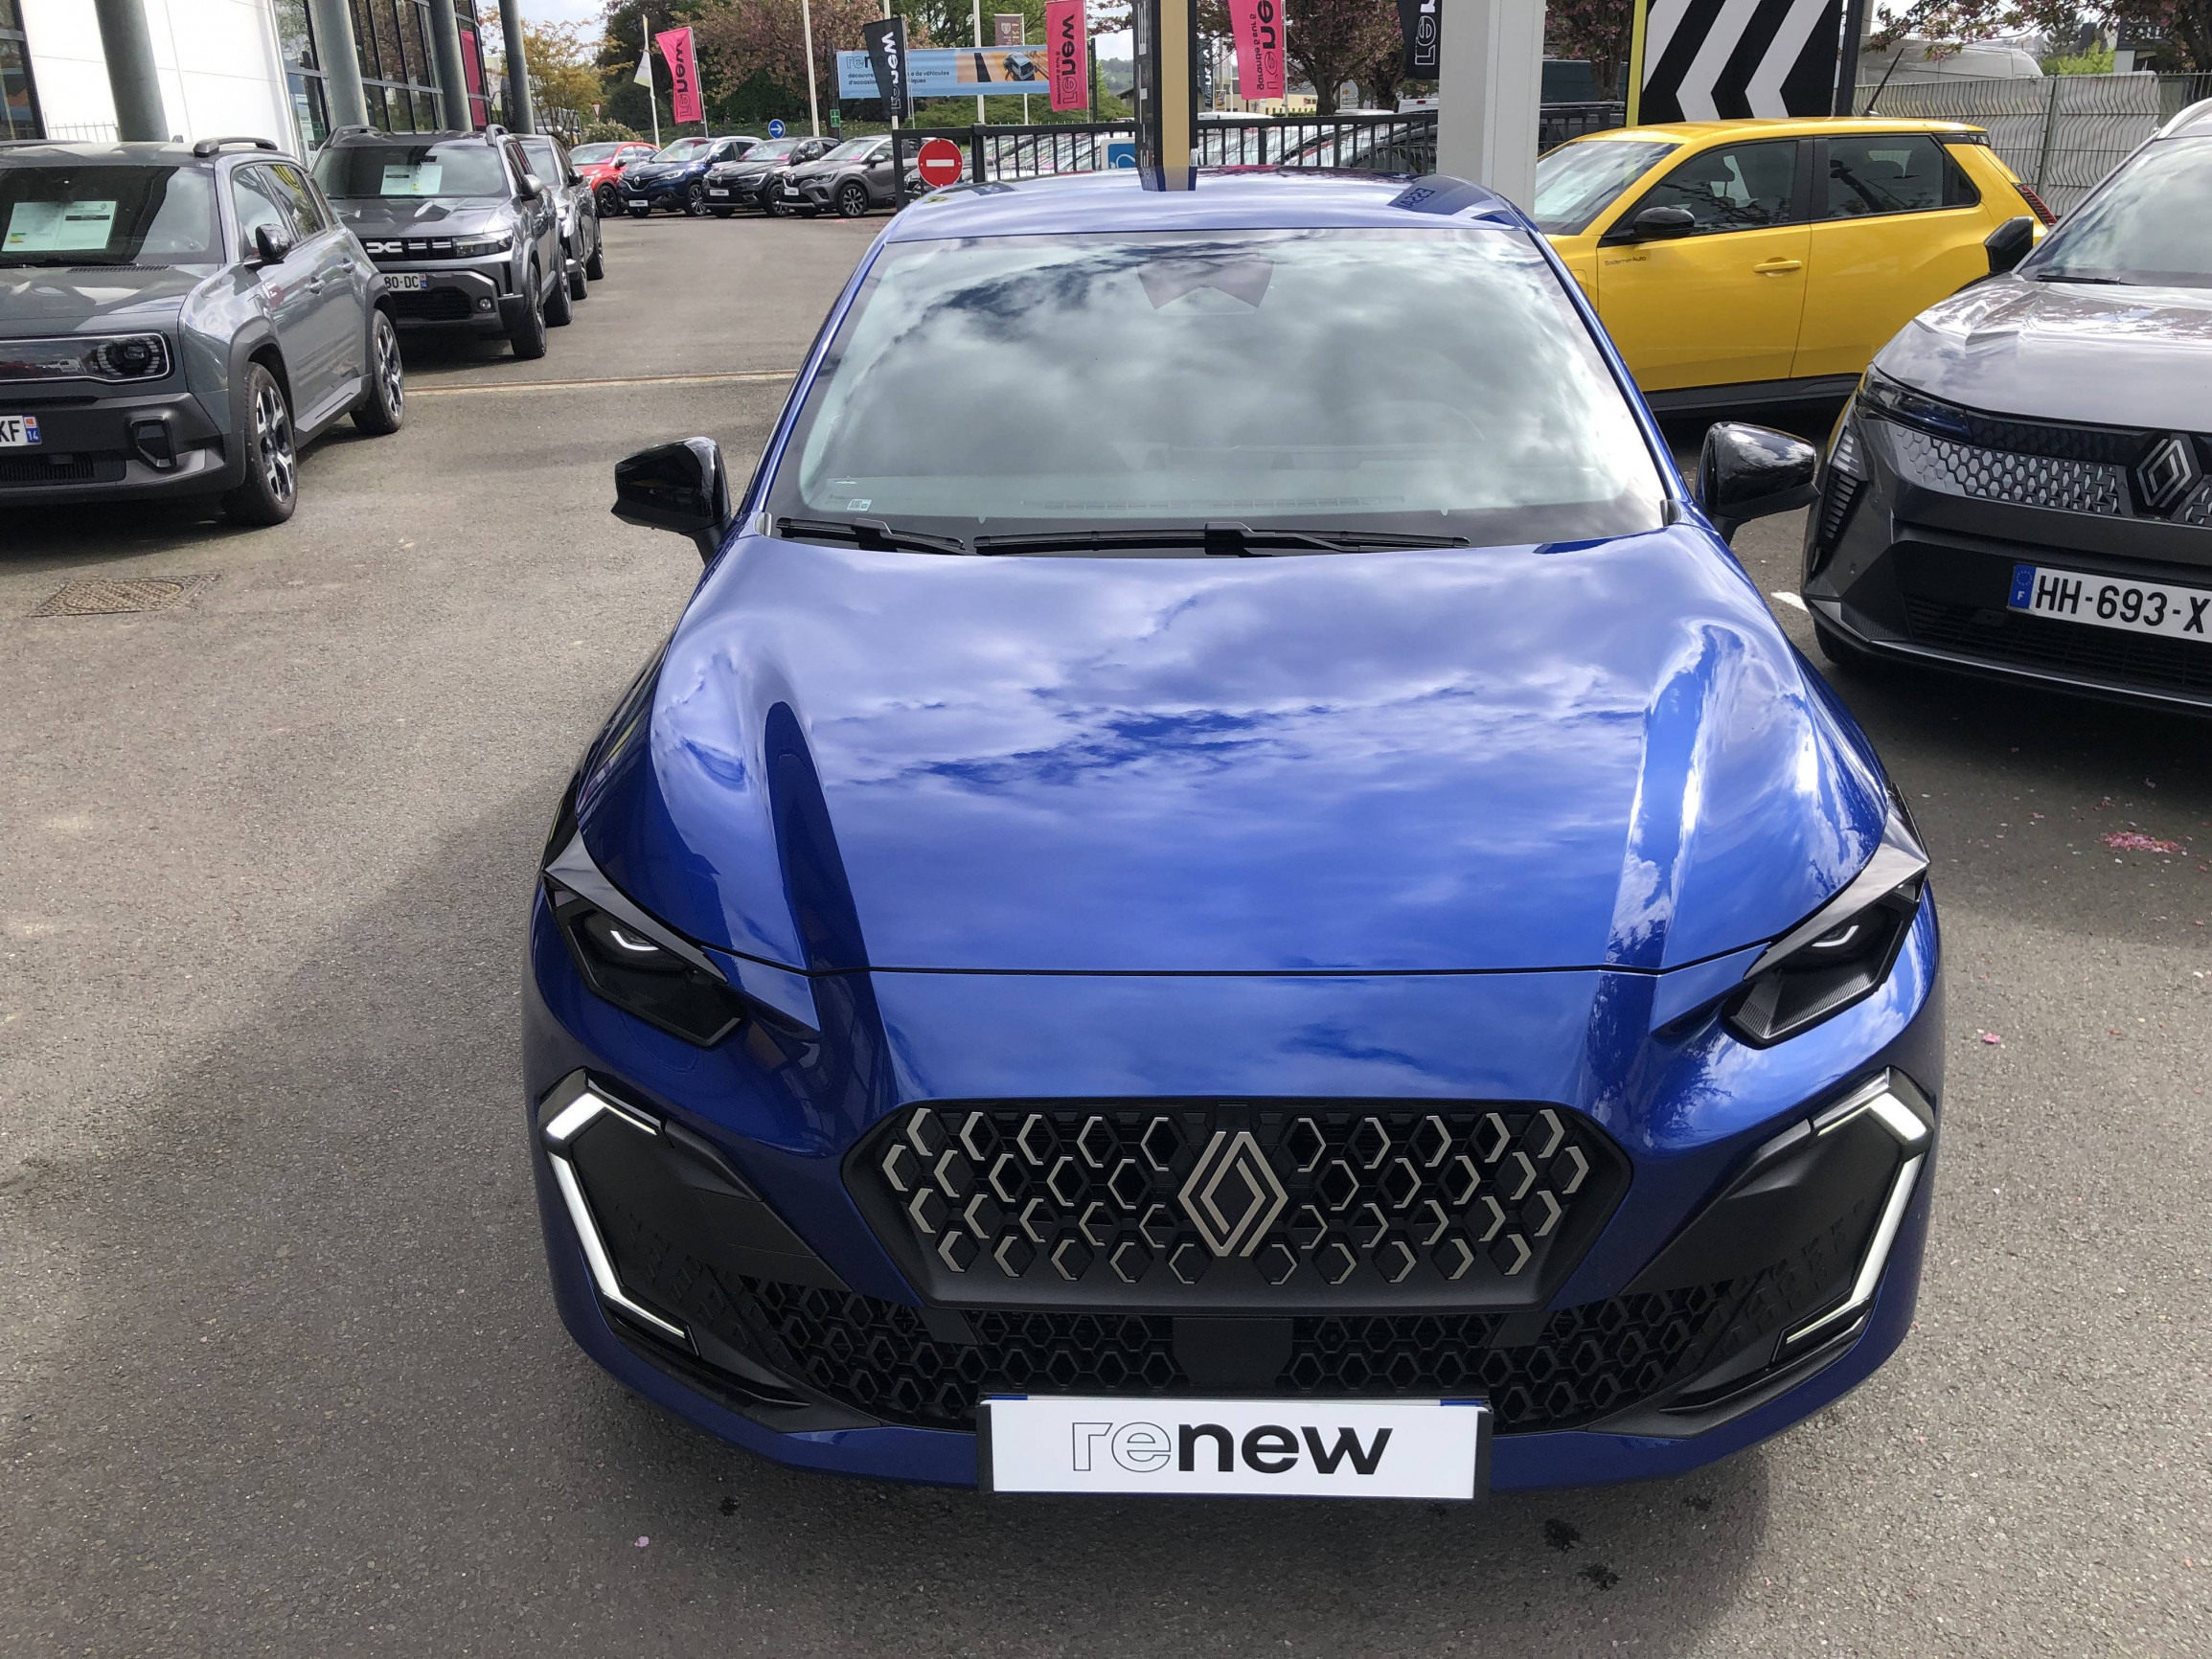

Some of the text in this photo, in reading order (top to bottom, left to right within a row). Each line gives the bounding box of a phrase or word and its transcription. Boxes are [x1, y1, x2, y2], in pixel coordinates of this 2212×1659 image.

[2017, 590, 2025, 601] F
[2035, 575, 2211, 634] HH-693-X
[1072, 1421, 1394, 1475] renew
